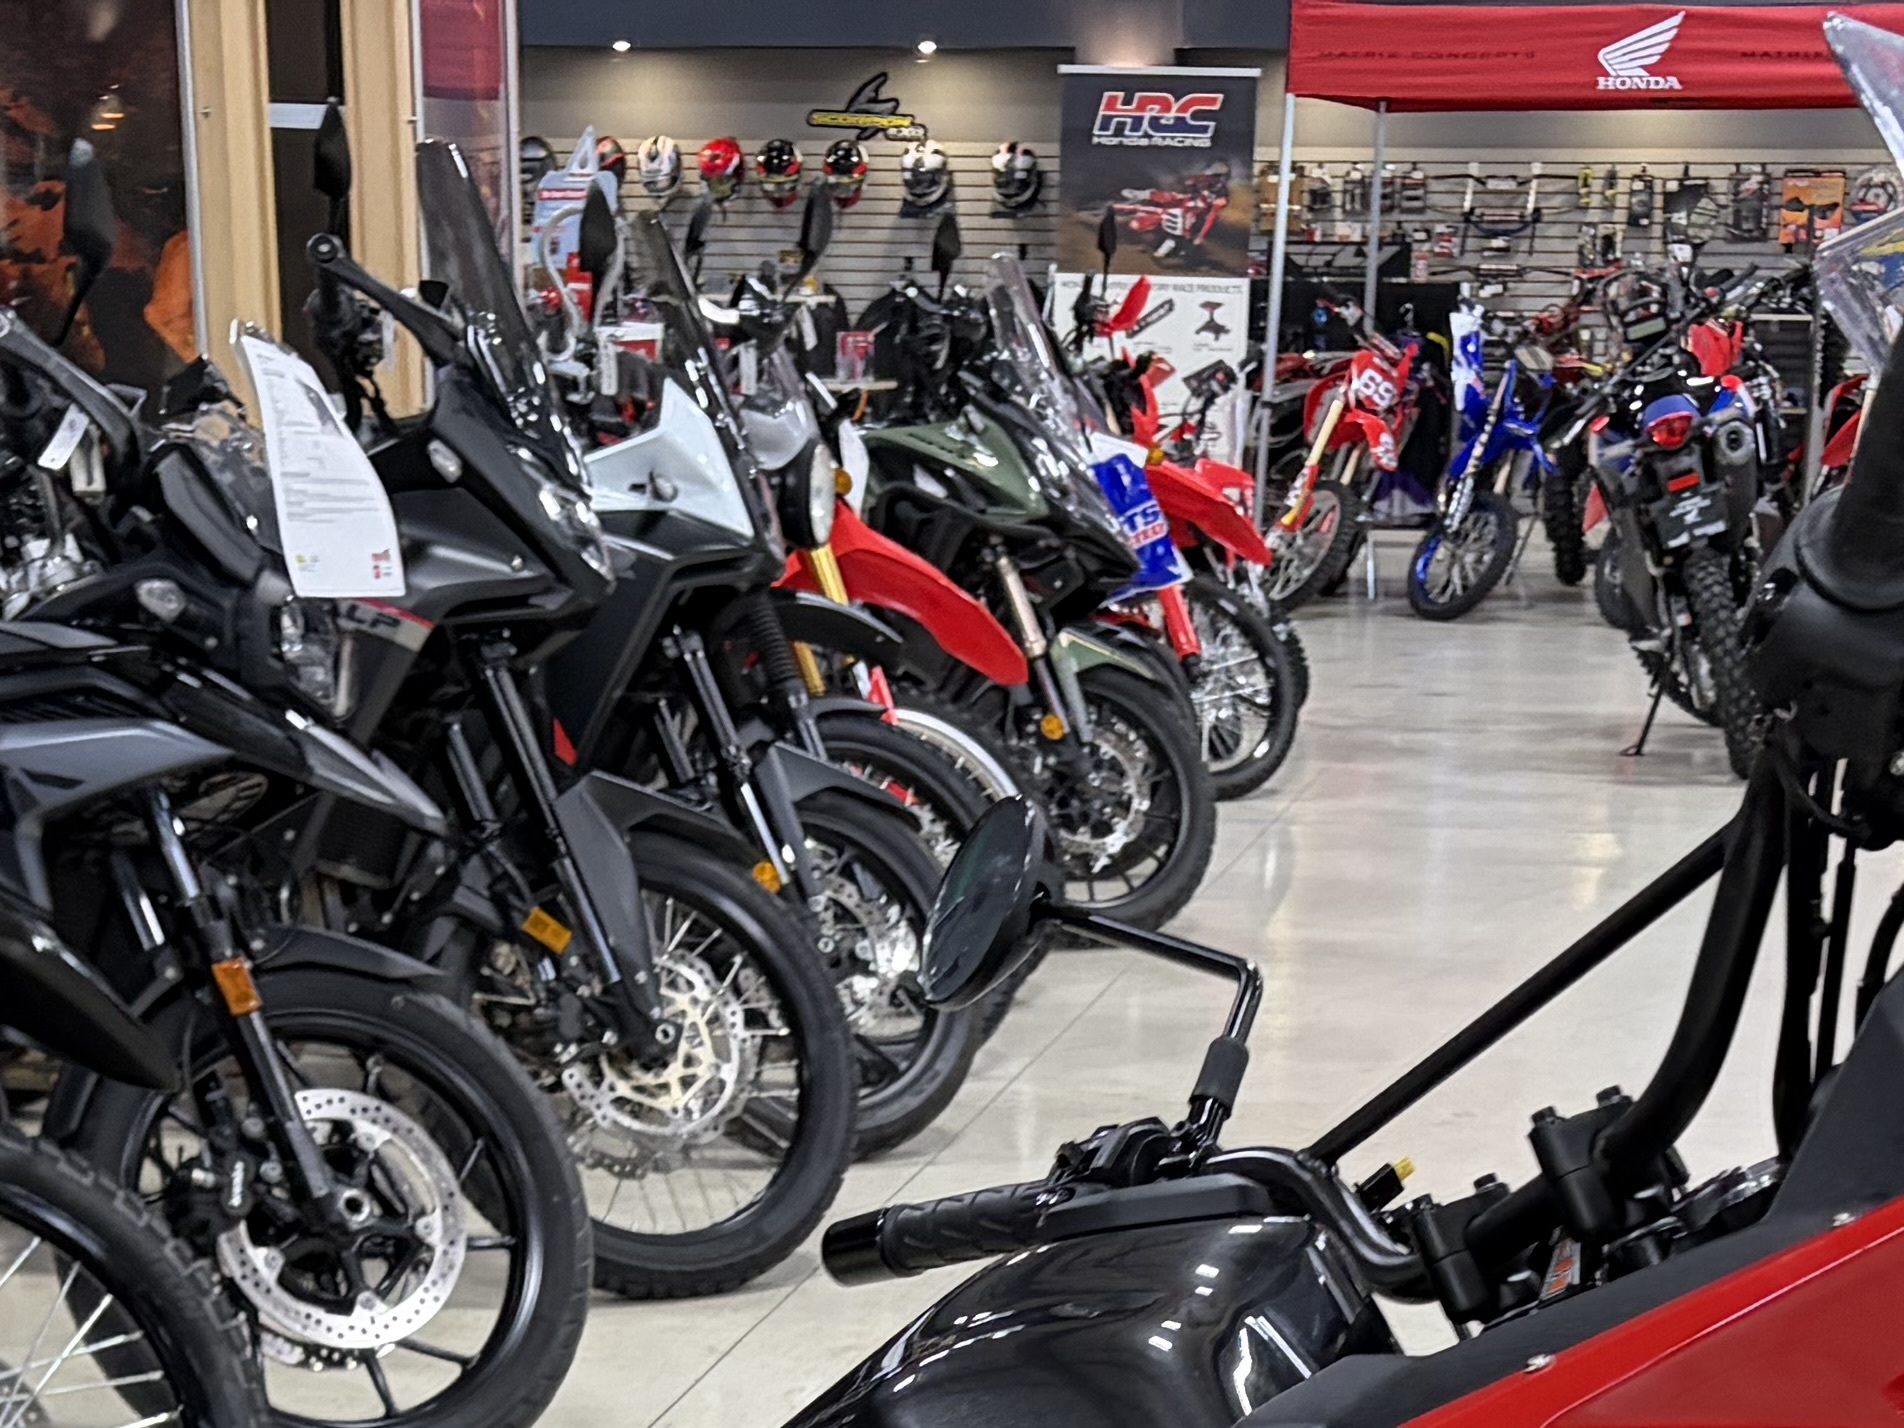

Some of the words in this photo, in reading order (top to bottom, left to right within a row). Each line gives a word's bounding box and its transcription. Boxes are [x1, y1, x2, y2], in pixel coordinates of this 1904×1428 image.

[1596, 76, 1683, 91] HONDA
[1092, 91, 1225, 138] HRC
[1091, 136, 1150, 146] Honda
[1151, 137, 1212, 148] RACING
